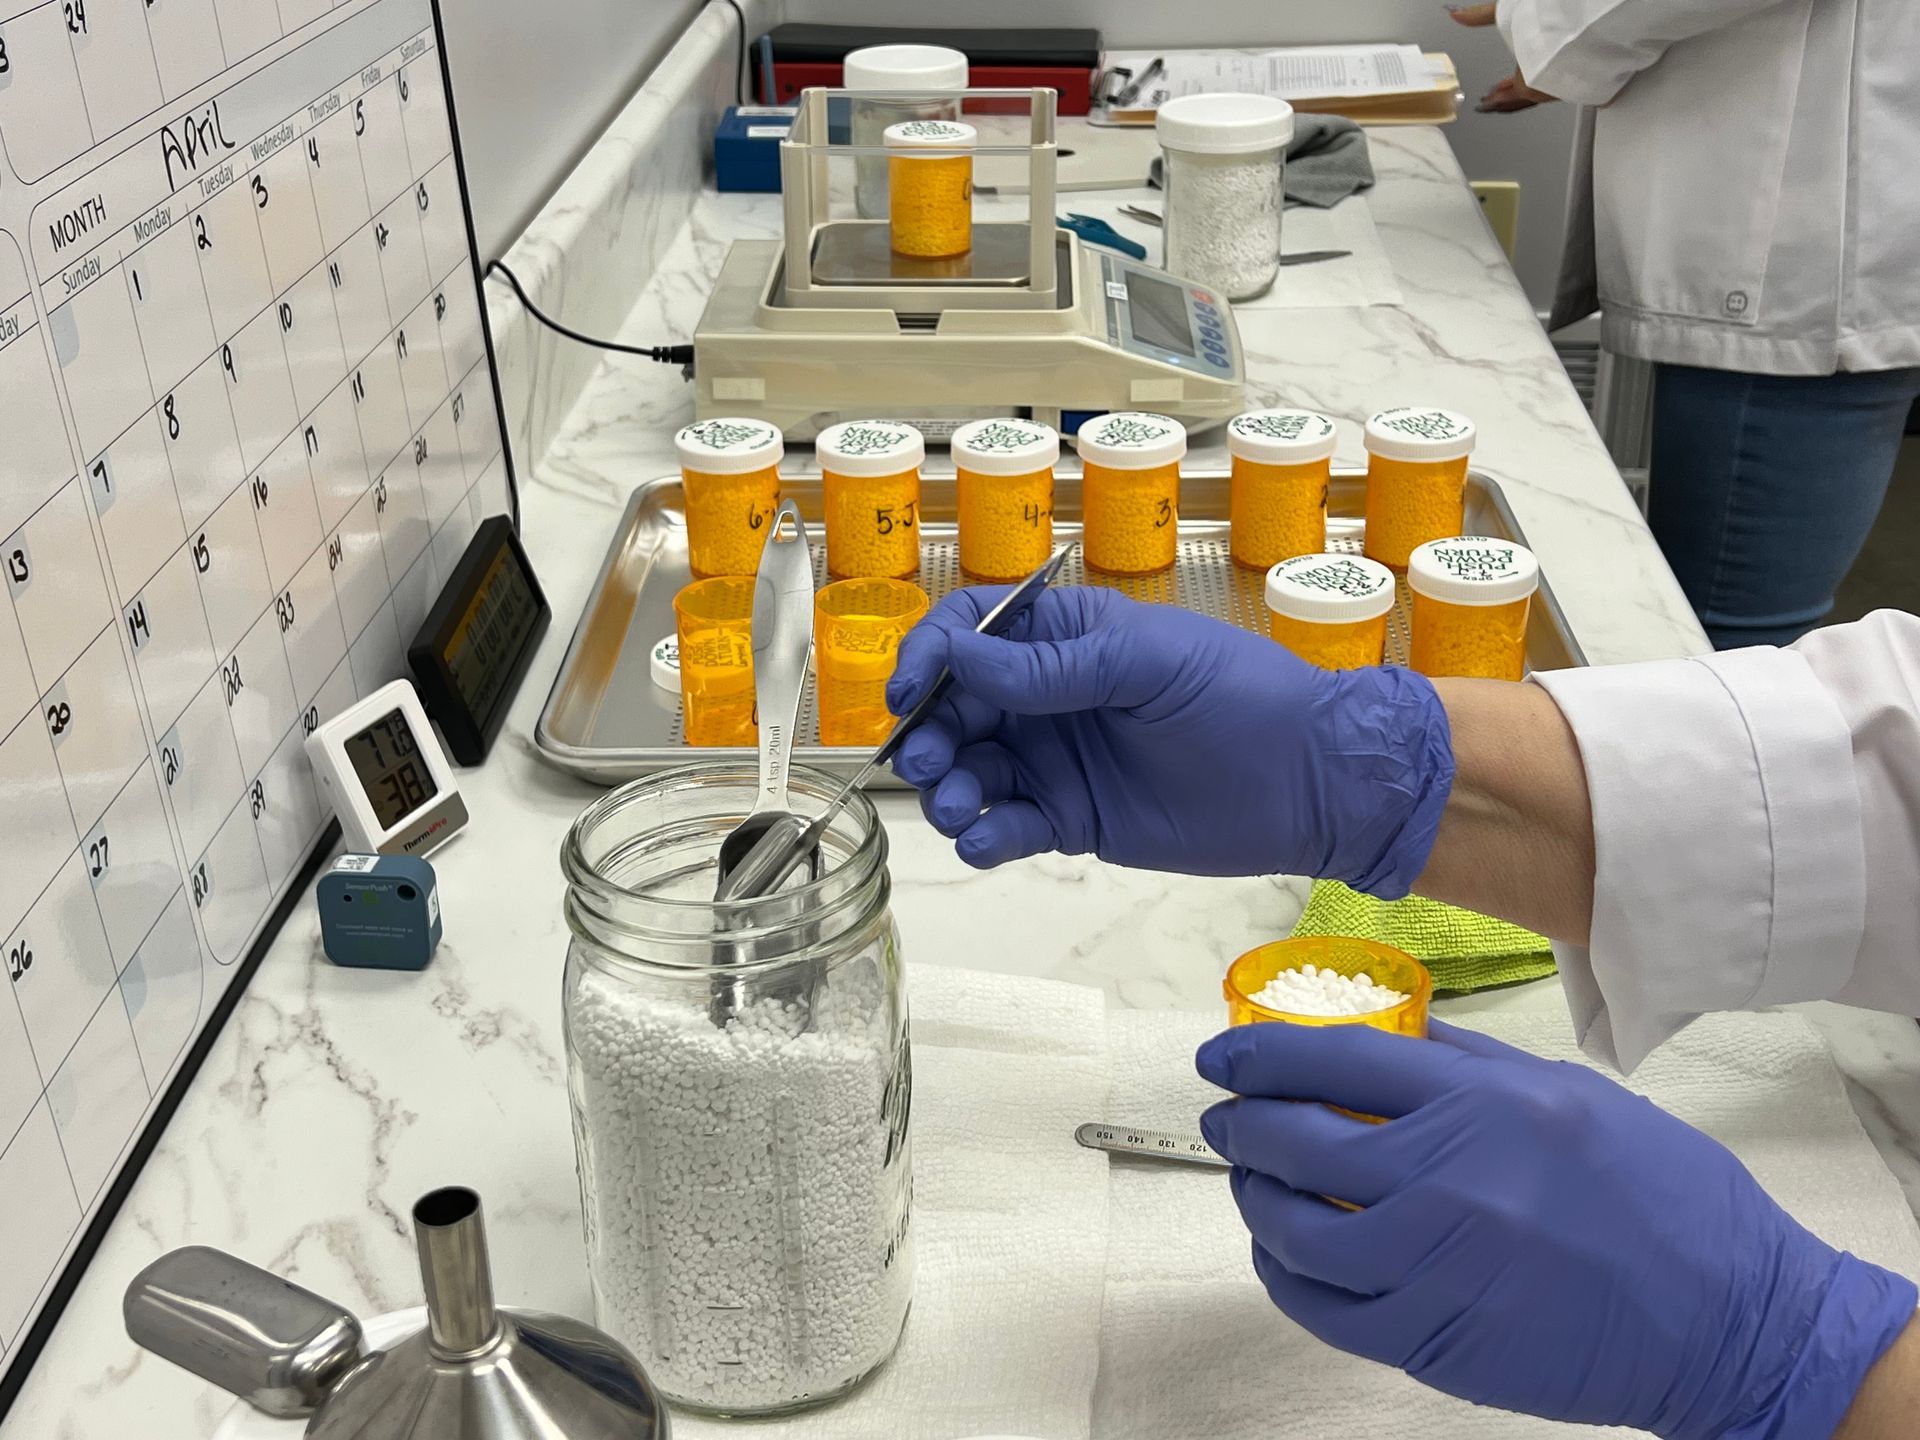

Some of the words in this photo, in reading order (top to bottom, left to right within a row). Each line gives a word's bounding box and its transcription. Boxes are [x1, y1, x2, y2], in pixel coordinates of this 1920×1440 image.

[65, 0, 87, 34] 24
[398, 69, 408, 102] 6
[355, 99, 365, 136] 5
[62, 255, 101, 295] Sunday
[133, 206, 172, 243] Monday
[197, 163, 235, 198] Tuesday
[250, 123, 295, 161] Wednesday
[307, 92, 341, 124] Thursday
[360, 64, 382, 88] Friday
[400, 36, 426, 62] Saturday
[308, 137, 320, 168] 4
[252, 174, 269, 208] 3
[416, 182, 429, 211] 13
[49, 194, 107, 253] MONTH
[195, 214, 212, 250] 2
[375, 222, 389, 251] 12
[132, 269, 143, 301] 1
[329, 262, 342, 288] 11
[279, 302, 293, 333] 10
[397, 329, 408, 359] 19
[222, 343, 237, 383] 9
[164, 394, 180, 440] 8
[304, 425, 318, 458] 17
[93, 460, 110, 493] 7
[252, 475, 268, 510] 16
[375, 476, 387, 514] 25
[1155, 497, 1171, 528] 3
[8, 549, 29, 583] 13
[193, 533, 210, 573] 15
[329, 534, 343, 571] 24
[1434, 548, 1494, 557] TURN
[1437, 555, 1513, 564] DOWN
[1286, 564, 1341, 583] TURN
[1299, 565, 1367, 588] DOWN
[1317, 574, 1371, 592] PUSH
[128, 600, 150, 647] 14
[276, 591, 295, 633] 23
[704, 637, 719, 667] DOWN
[717, 635, 732, 660] TURN
[222, 654, 244, 707] 22
[47, 702, 71, 735] 20
[768, 725, 781, 757] 20ml
[162, 747, 179, 785] 21
[767, 761, 782, 781] tsp
[251, 779, 267, 820] 29
[377, 761, 427, 821] 38
[766, 785, 778, 795] 4
[402, 817, 448, 852] ThermoPro
[90, 835, 109, 878] 27
[11, 939, 33, 983] 26
[1096, 1131, 1114, 1140] 150
[1127, 1135, 1145, 1144] 140
[1158, 1139, 1176, 1148] 130
[1189, 1143, 1207, 1152] 120
